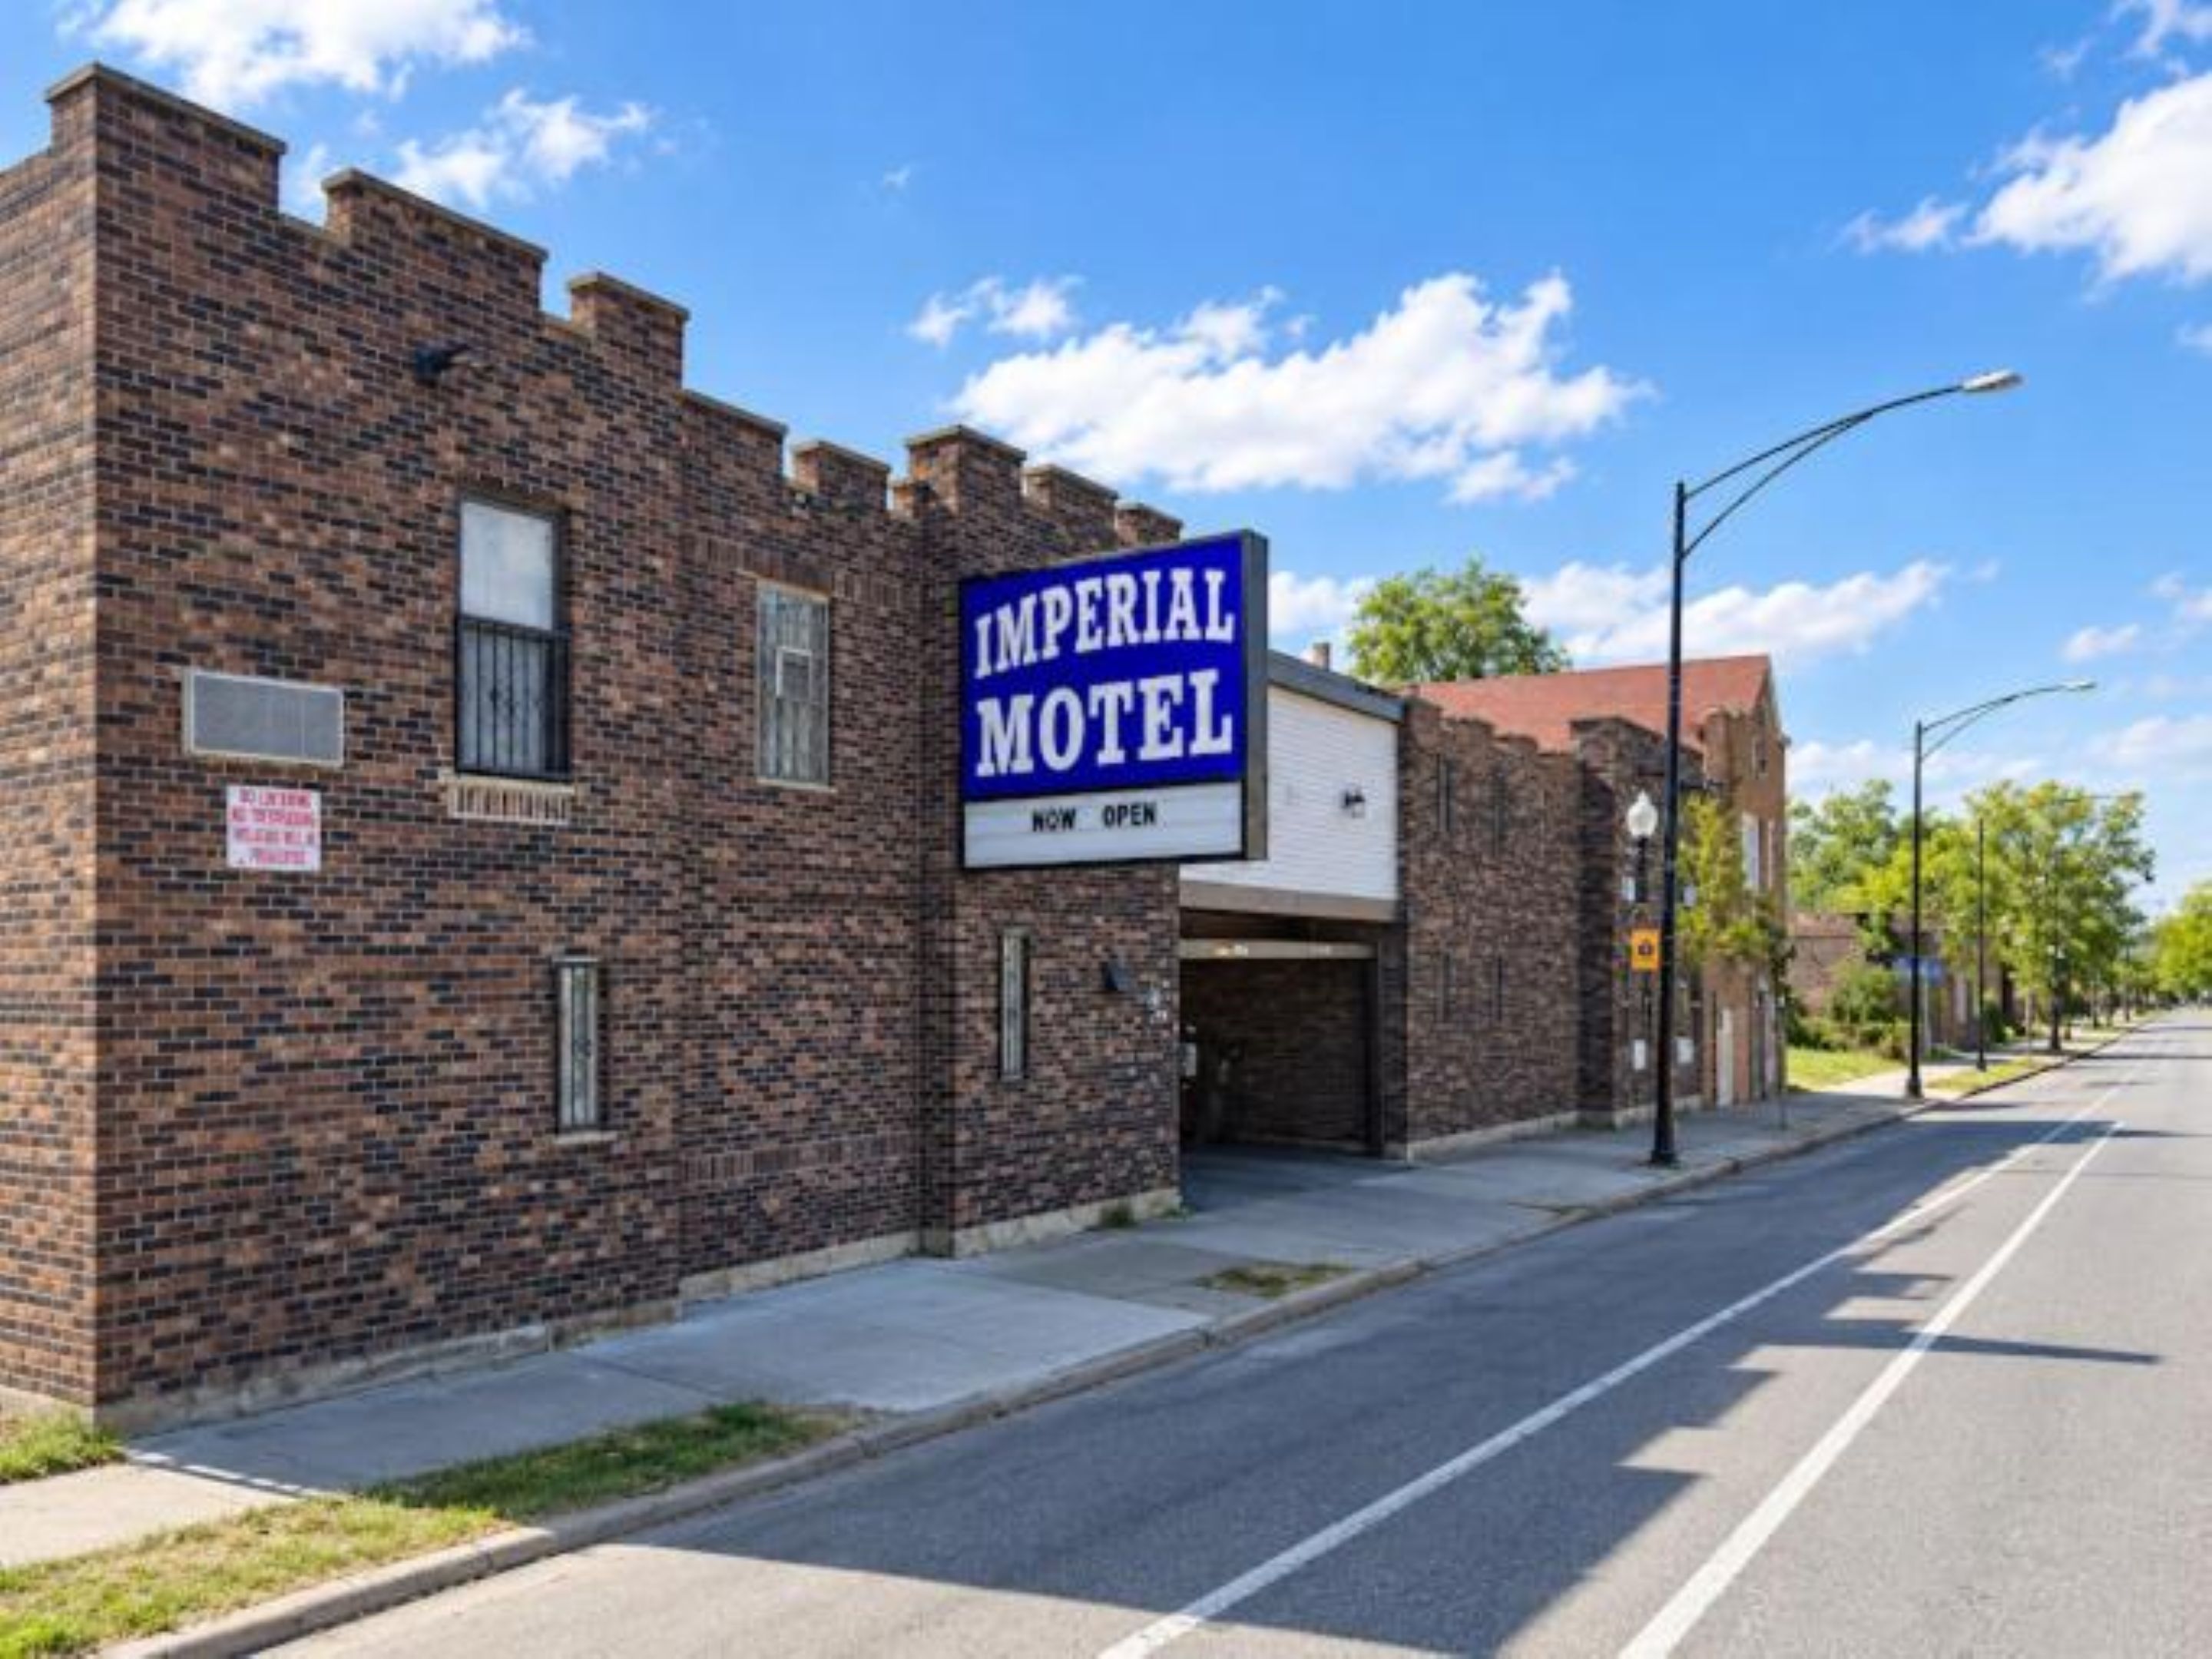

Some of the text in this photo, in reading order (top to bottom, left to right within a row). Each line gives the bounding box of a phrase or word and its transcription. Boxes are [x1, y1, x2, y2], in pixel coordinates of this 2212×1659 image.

[975, 568, 1234, 678] IMPERIAL
[976, 669, 1232, 777] MOTEL
[1032, 803, 1156, 832] NOW OPEN
